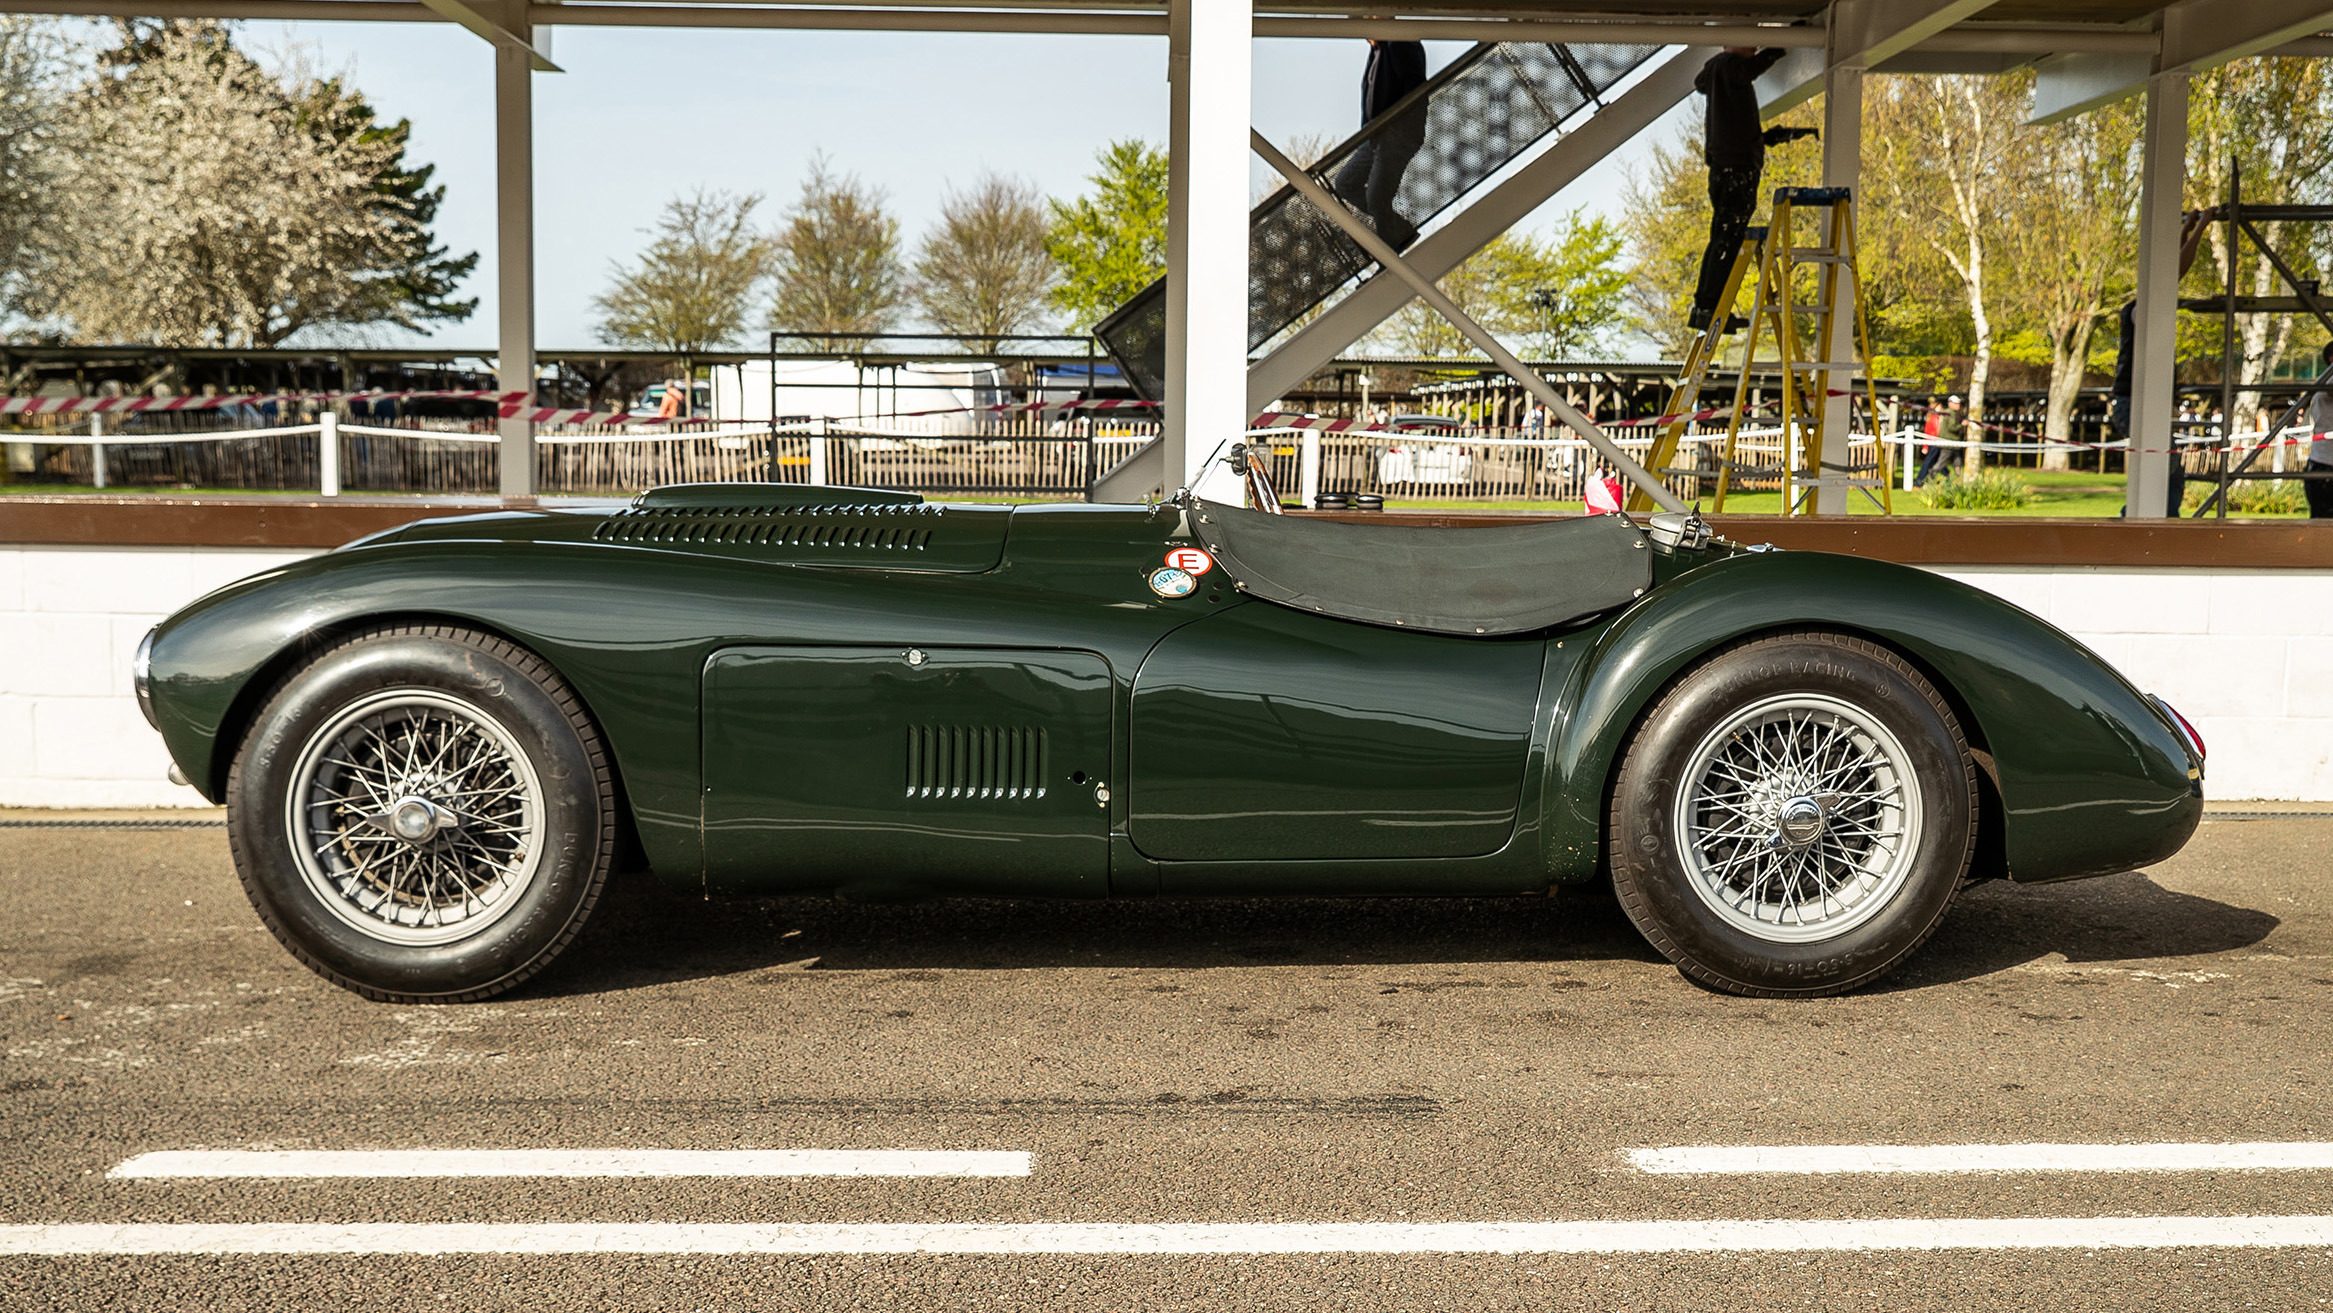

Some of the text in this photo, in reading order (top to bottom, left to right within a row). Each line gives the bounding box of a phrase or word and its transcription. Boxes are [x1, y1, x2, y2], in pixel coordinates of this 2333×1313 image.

[1178, 553, 1199, 571] E
[1711, 660, 1857, 704] DUNLOP RACING
